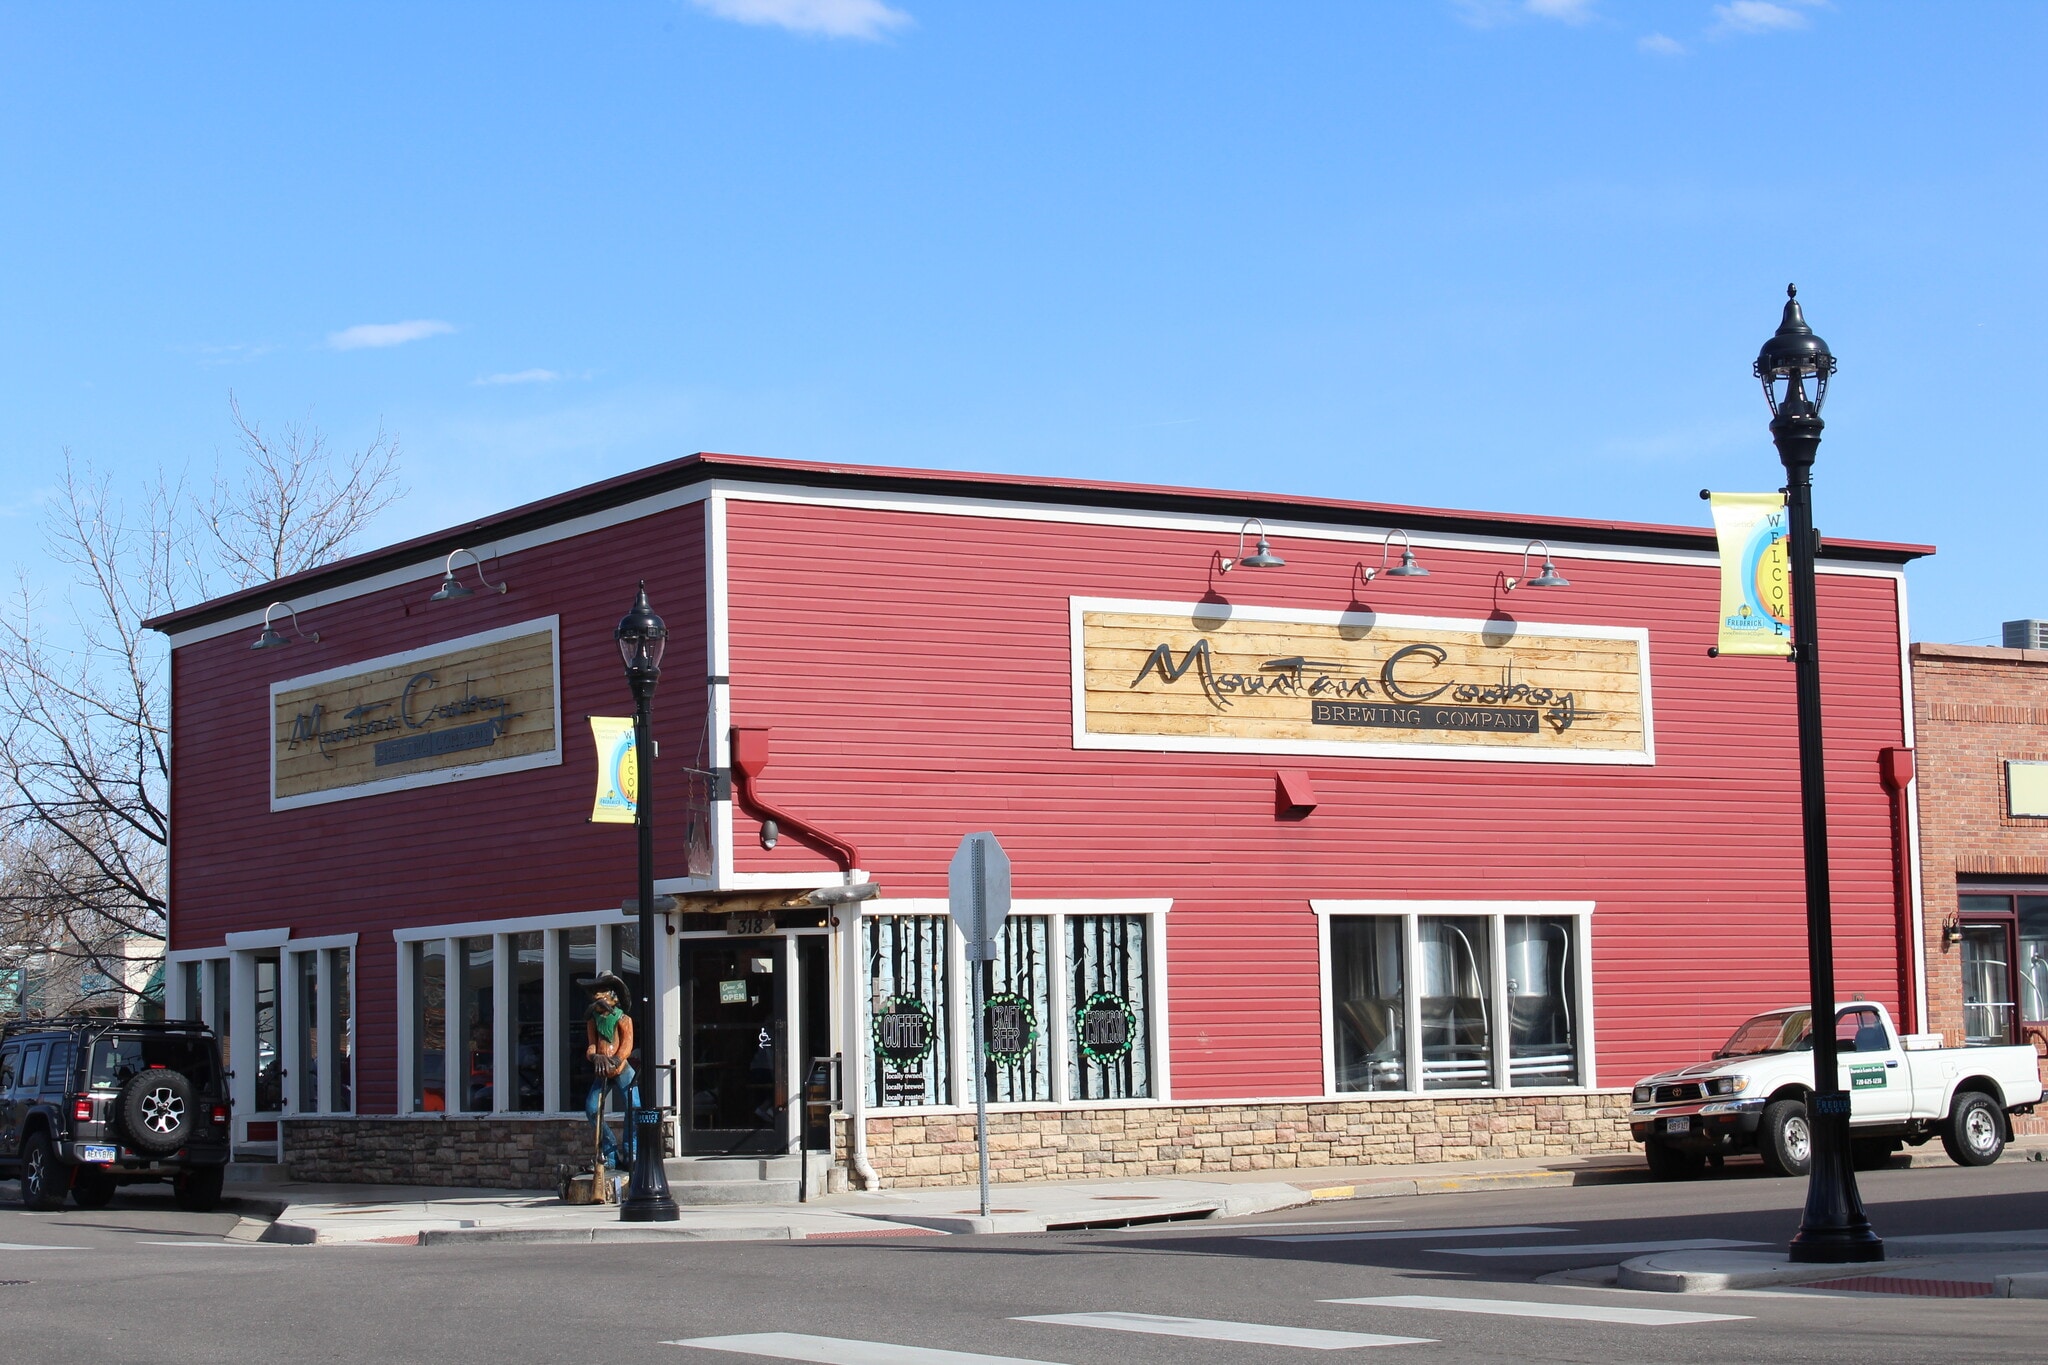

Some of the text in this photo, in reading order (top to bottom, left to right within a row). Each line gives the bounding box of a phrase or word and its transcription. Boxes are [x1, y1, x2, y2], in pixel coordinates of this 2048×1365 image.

[1766, 514, 1785, 635] WELCOME
[1727, 618, 1762, 627] FREDERICK
[1384, 643, 1606, 730] Cowboy
[1316, 705, 1536, 729] BREWING COMPANY
[624, 731, 635, 811] WELCOME
[737, 918, 763, 934] 318
[722, 993, 745, 1001] OPEN
[991, 1005, 1021, 1029] CRAFT
[1085, 1010, 1126, 1045] ESPRESSO
[883, 1013, 924, 1049] COFFEE
[991, 1029, 1021, 1052] BEER
[886, 1072, 904, 1080] locally
[886, 1082, 924, 1091] locally brewed
[886, 1092, 925, 1101] locally roasted
